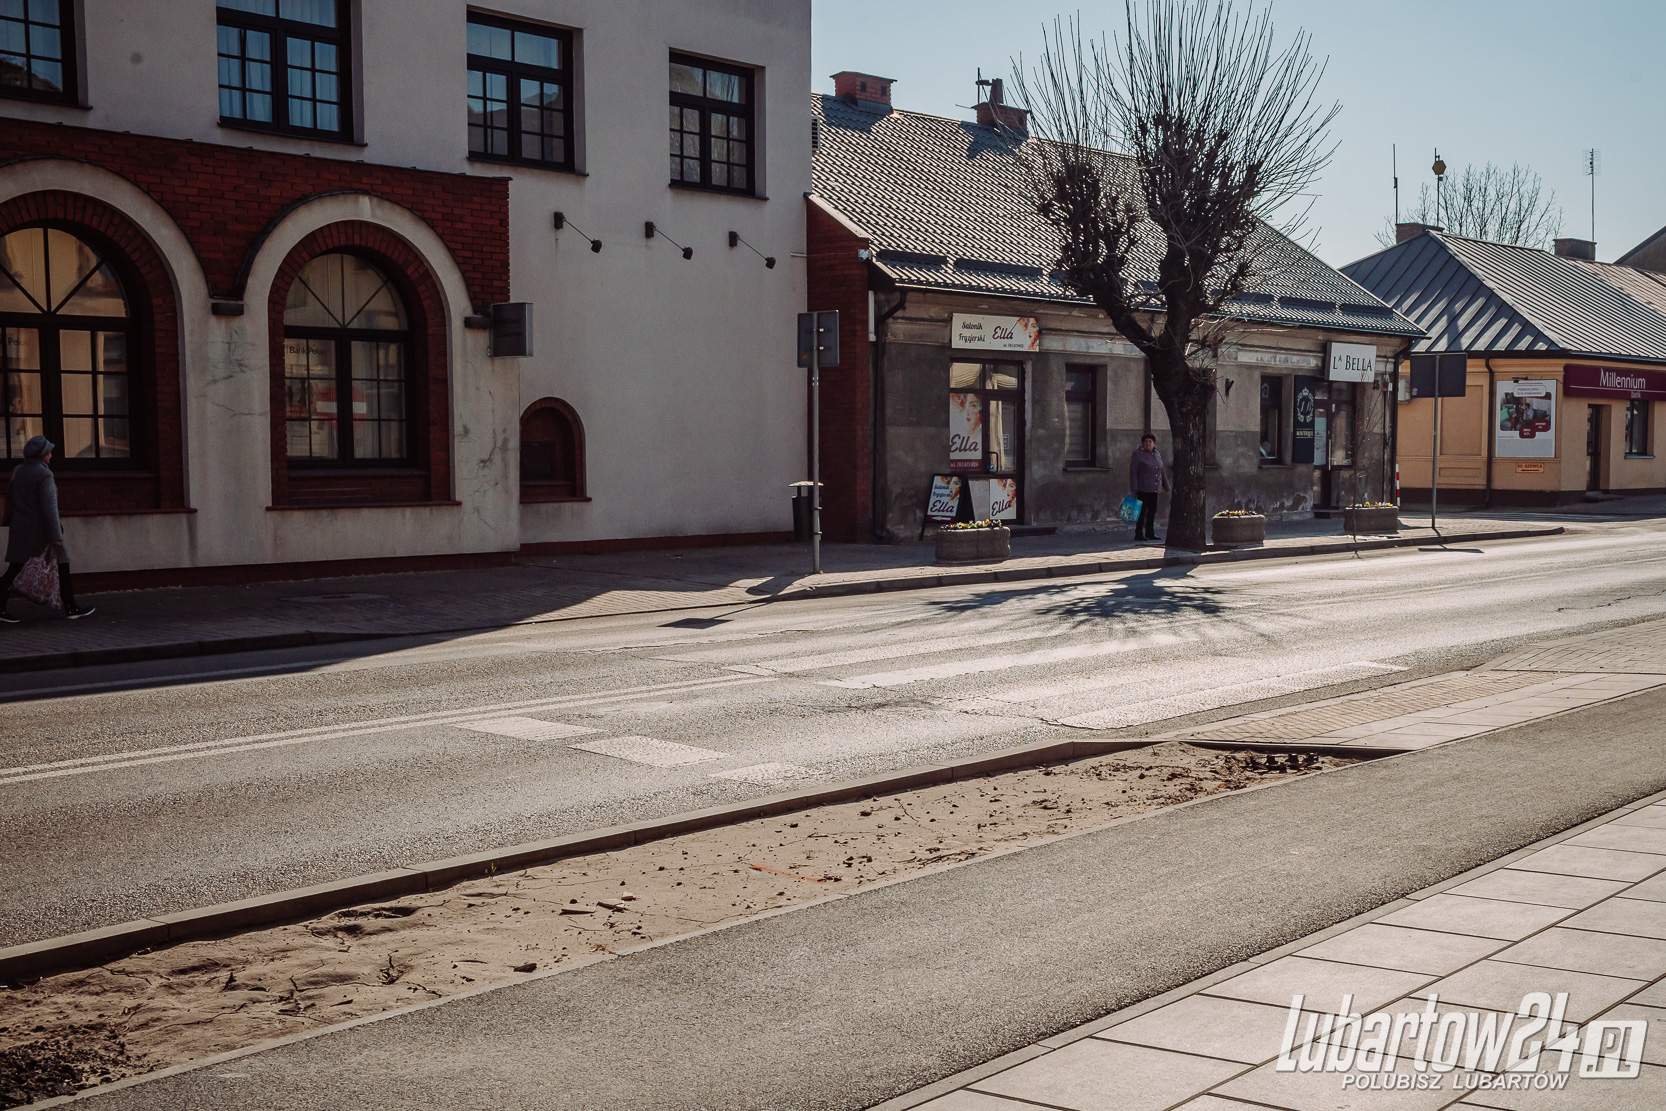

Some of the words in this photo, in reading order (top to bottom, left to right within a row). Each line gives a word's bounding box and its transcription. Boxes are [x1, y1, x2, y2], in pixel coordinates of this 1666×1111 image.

[961, 322, 983, 330] Salonik
[992, 325, 1014, 340] Ella
[1345, 354, 1373, 372] BELLA
[1599, 367, 1646, 390] Millennium
[949, 433, 980, 455] Ella
[930, 499, 954, 513] Ella
[991, 498, 1012, 517] Ella
